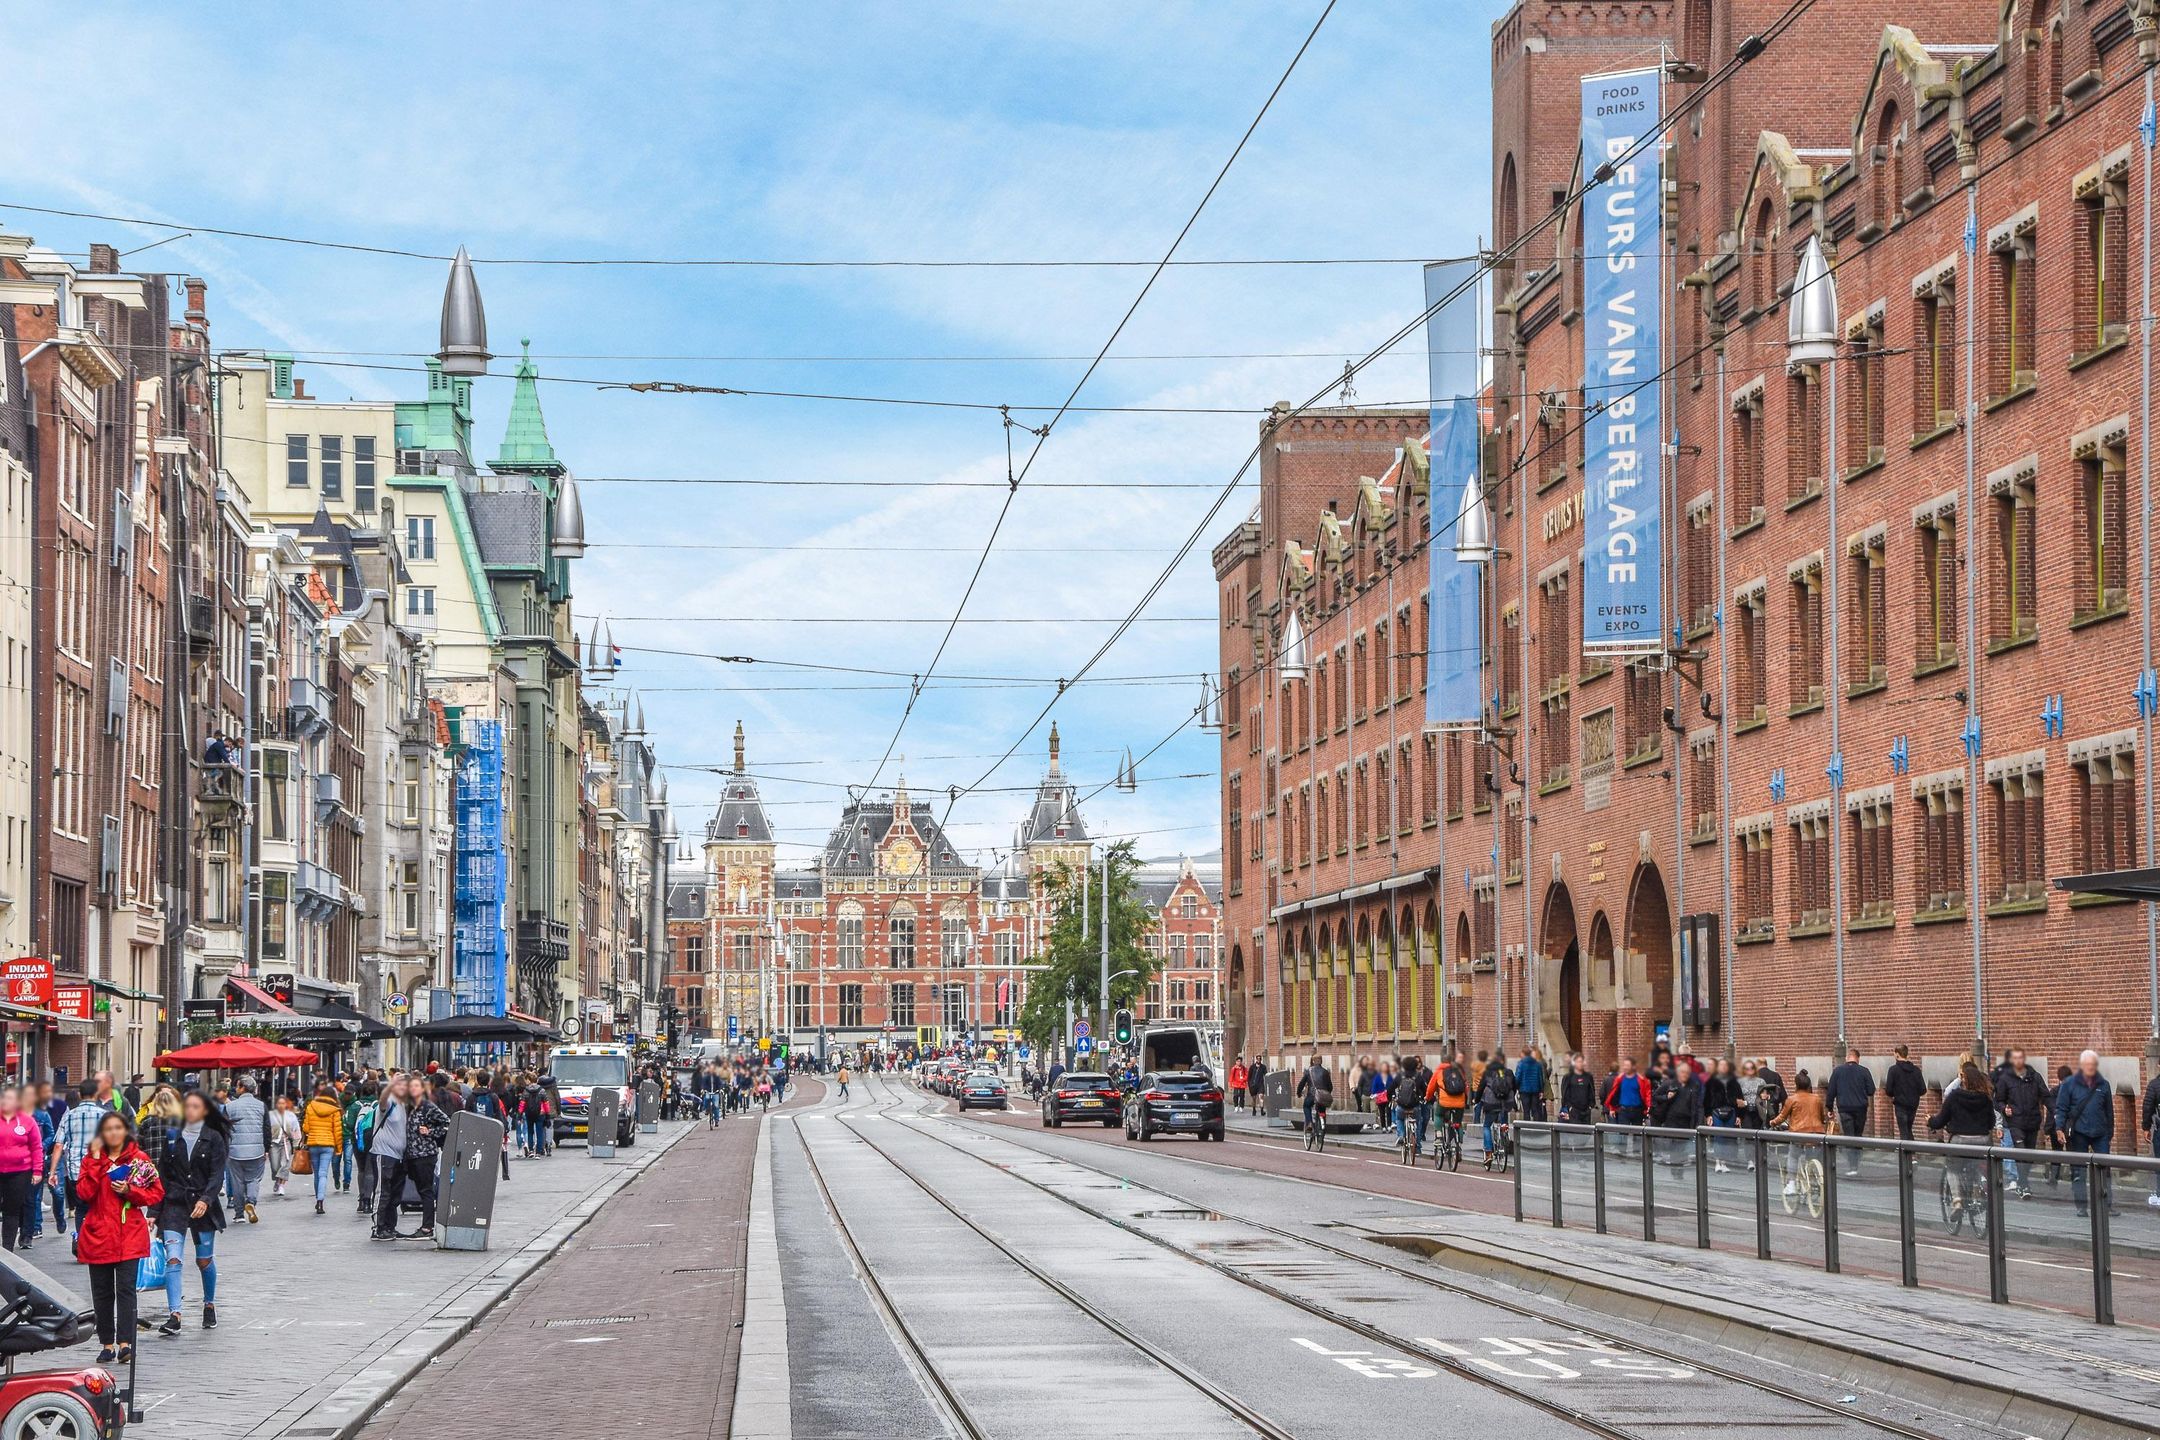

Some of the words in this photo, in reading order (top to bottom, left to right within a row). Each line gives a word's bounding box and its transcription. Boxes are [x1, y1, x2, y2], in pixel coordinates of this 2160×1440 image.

[1602, 86, 1639, 100] FOOD
[1597, 101, 1645, 117] DRINKS
[1607, 135, 1635, 274] BEURS
[1608, 290, 1636, 377] VAN
[1608, 396, 1637, 584] BERLAGE
[1543, 498, 1572, 541] BEURS
[1598, 605, 1648, 617] EVENTS
[1605, 621, 1640, 632] EXPO
[9, 964, 45, 973] INDIAN
[271, 1020, 331, 1028] STEAKHOUSE
[1332, 1357, 1696, 1379] BUS
